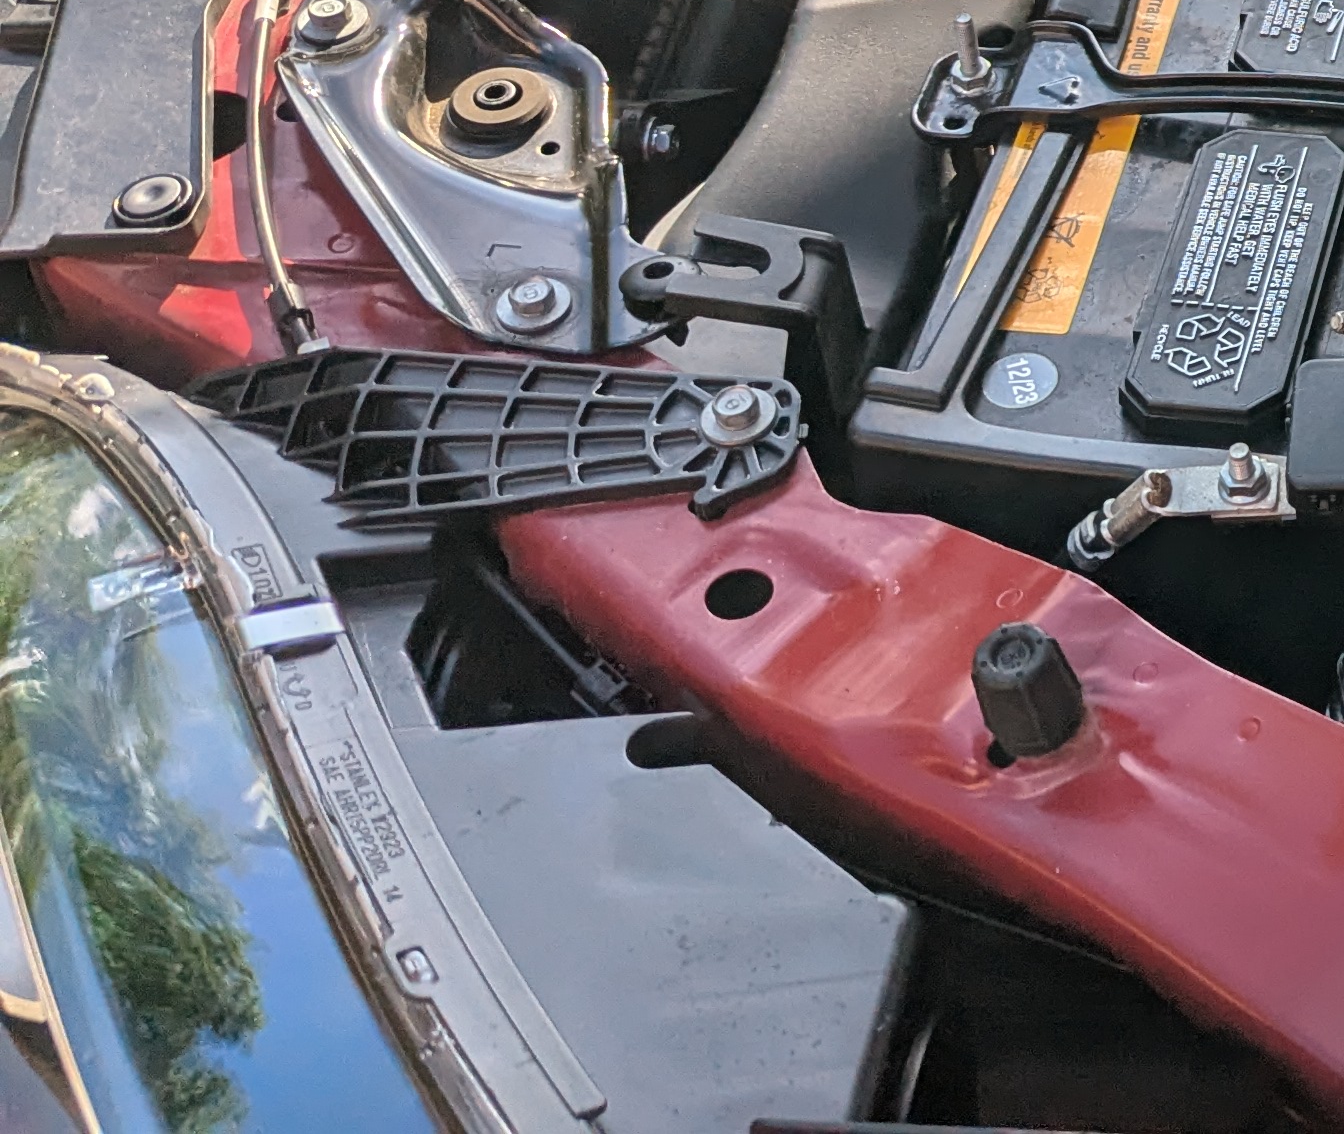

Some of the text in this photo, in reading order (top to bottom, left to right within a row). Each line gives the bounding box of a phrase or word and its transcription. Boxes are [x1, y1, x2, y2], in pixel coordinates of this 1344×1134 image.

[1131, 36, 1151, 60] and
[1285, 33, 1300, 51] ACID
[1256, 183, 1273, 205] WITH
[1220, 200, 1233, 216] SAFE
[1291, 199, 1304, 212] NOT
[1223, 182, 1260, 265] MEDICAL HELP FAST
[1295, 221, 1308, 236] OUT
[1244, 183, 1288, 292] FLUSH EYES IMMEDIATELY
[1281, 229, 1295, 247] KEEP
[1240, 239, 1257, 257] GET
[1288, 248, 1301, 262] THE
[1275, 249, 1289, 267] VENT
[1269, 268, 1284, 287] CAPS
[1262, 289, 1278, 311] TIGHT
[1227, 311, 1250, 328] LEAD
[1257, 312, 1271, 328] AND
[1151, 324, 1169, 361] RECYCLE
[1250, 329, 1266, 353] LEVEL
[1006, 357, 1039, 405] 12/23
[318, 755, 346, 783] SAE
